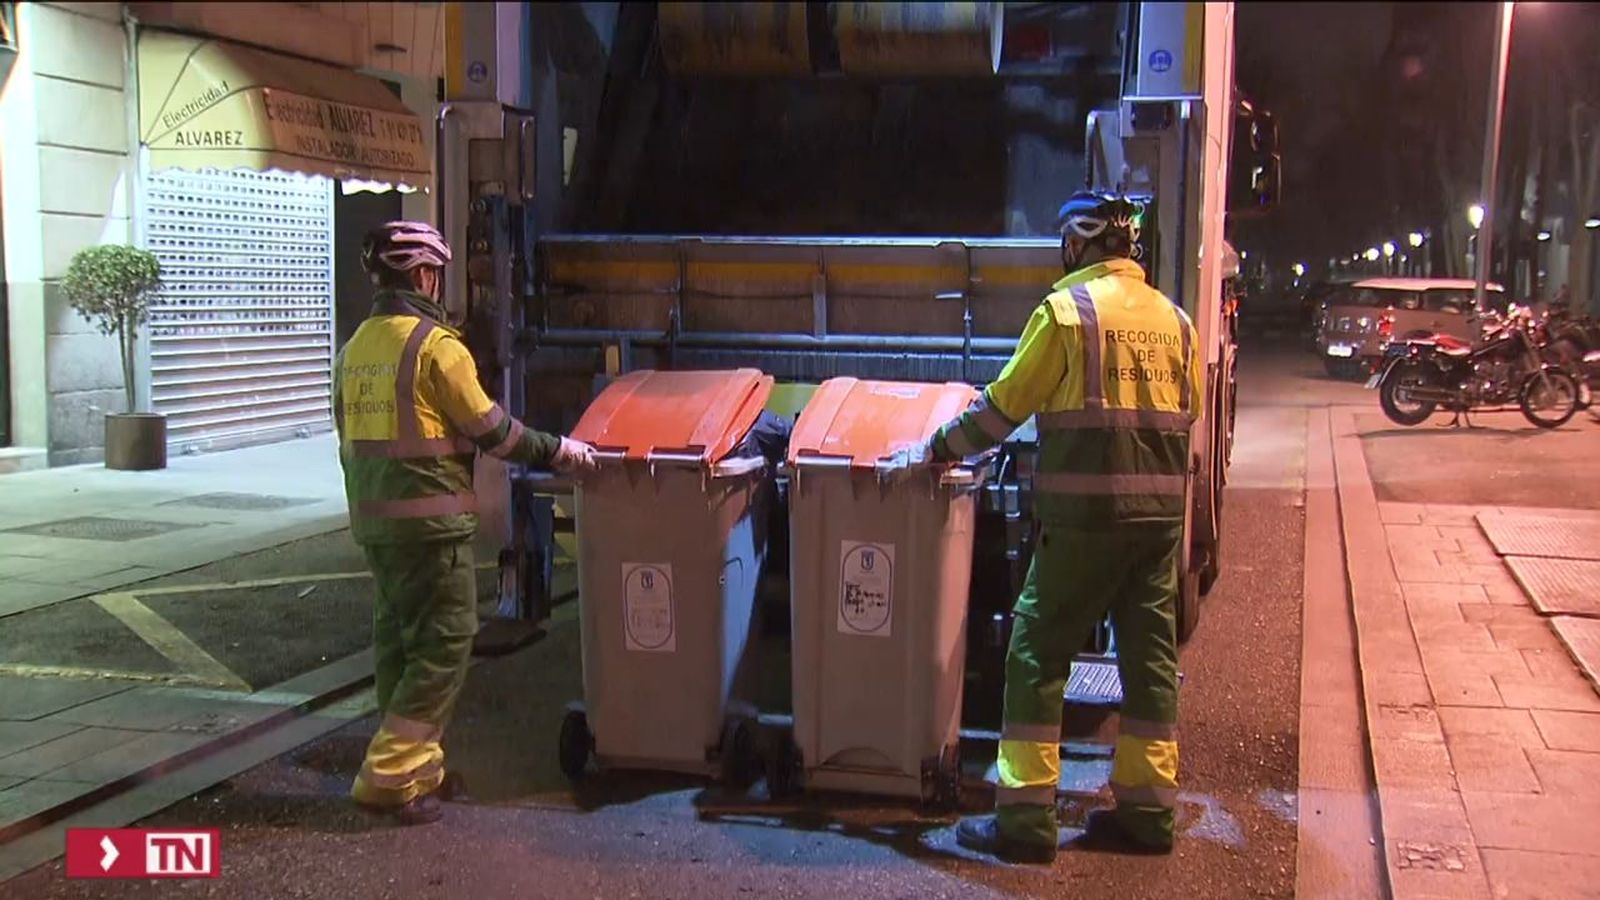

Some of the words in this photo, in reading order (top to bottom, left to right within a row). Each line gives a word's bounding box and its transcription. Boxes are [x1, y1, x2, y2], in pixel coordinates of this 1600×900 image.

[163, 80, 229, 128] Electricidad
[175, 130, 243, 145] ALVAREZ
[1105, 329, 1179, 346] RECOGIDA
[1137, 349, 1155, 363] DE
[1108, 367, 1177, 384] RESIDUOS
[360, 382, 374, 396] DE
[343, 401, 394, 415] ESIDUOS
